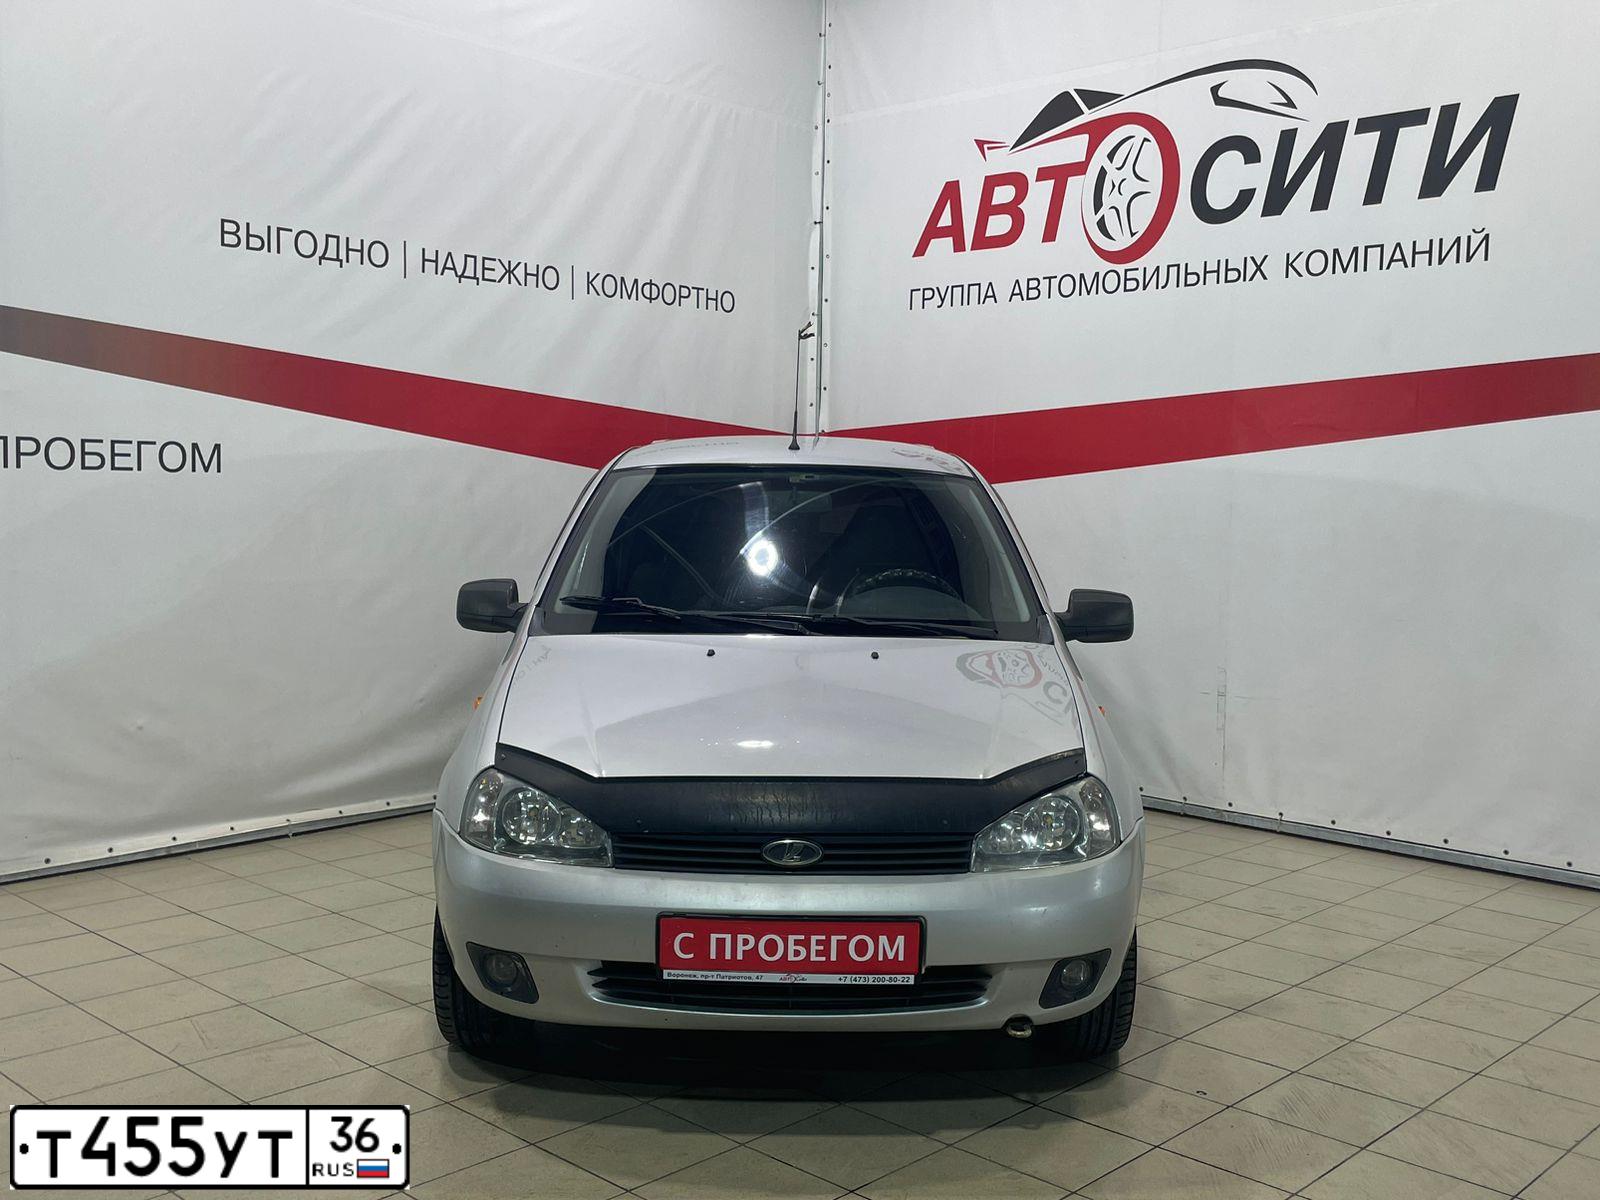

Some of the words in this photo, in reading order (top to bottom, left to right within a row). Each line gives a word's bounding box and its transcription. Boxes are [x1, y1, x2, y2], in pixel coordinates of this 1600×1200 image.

[220, 218, 389, 269] ВЫГОДНО
[421, 247, 560, 291] НАДЕЖНО
[586, 271, 736, 314] КОМФОРТНО
[909, 281, 998, 311] ГРУППА
[1008, 253, 1269, 303] АВТОМОБИЛЬНЫХ
[1284, 227, 1490, 279] КОМПАНИЙ
[673, 932, 694, 959] С
[710, 933, 905, 962] ПРОБЕГОМ
[850, 976, 870, 984] (473)
[872, 976, 911, 984] 200-80-22
